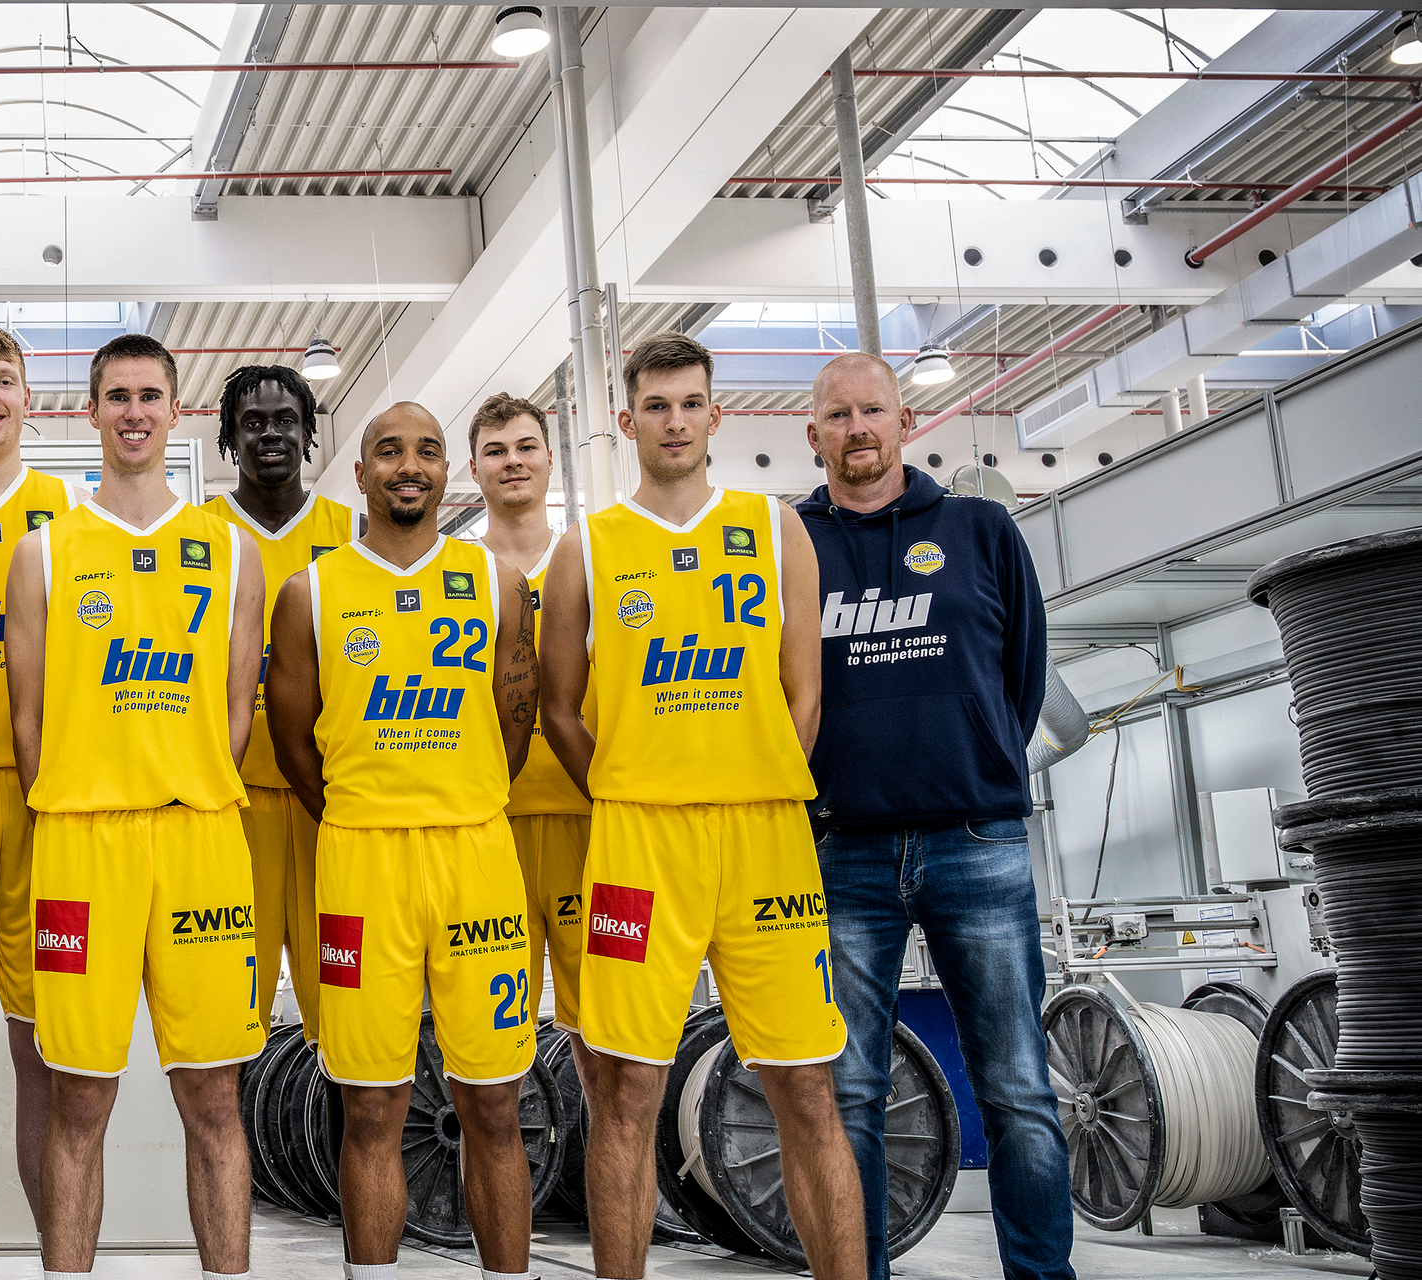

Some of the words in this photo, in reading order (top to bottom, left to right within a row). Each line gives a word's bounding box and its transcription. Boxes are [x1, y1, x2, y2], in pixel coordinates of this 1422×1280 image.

[184, 560, 208, 568] BARMER
[904, 552, 946, 566] Baskets
[74, 572, 105, 582] CRAFT
[614, 572, 646, 582] CRAFT
[184, 584, 212, 633] 7
[617, 599, 656, 618] Baskets
[712, 573, 766, 628] 12
[76, 602, 114, 618] Baskets
[342, 610, 373, 618] CRAFT
[821, 588, 932, 638] biw
[344, 636, 380, 656] Baskets
[430, 617, 488, 673] 22
[849, 640, 886, 653] When
[891, 637, 900, 649] it
[904, 634, 947, 648] comes
[101, 638, 194, 686] biw
[641, 634, 745, 686] biw
[848, 654, 860, 666] to
[864, 647, 944, 664] competence
[114, 690, 143, 702] When
[147, 689, 155, 700] it
[159, 692, 190, 704] comes
[363, 674, 465, 722] biw
[656, 691, 690, 703] When
[693, 689, 700, 700] it
[705, 689, 742, 700] comes
[112, 703, 122, 714] to
[124, 702, 187, 714] competence
[654, 704, 664, 716] to
[668, 700, 739, 714] competence
[378, 728, 410, 738] When
[414, 728, 422, 738] it
[426, 728, 460, 738] comes
[374, 740, 385, 750] to
[389, 740, 457, 752] competence
[172, 905, 253, 934] ZWICK
[558, 918, 582, 926] ARMAT
[757, 922, 805, 932] ARMATUREN
[447, 914, 525, 947] ZWICK
[173, 936, 219, 945] ARMATUREN
[490, 944, 509, 953] GMBH
[246, 956, 256, 1009] 7
[815, 949, 835, 1003] 1
[490, 968, 528, 1030] 22
[246, 1022, 259, 1031] CRA
